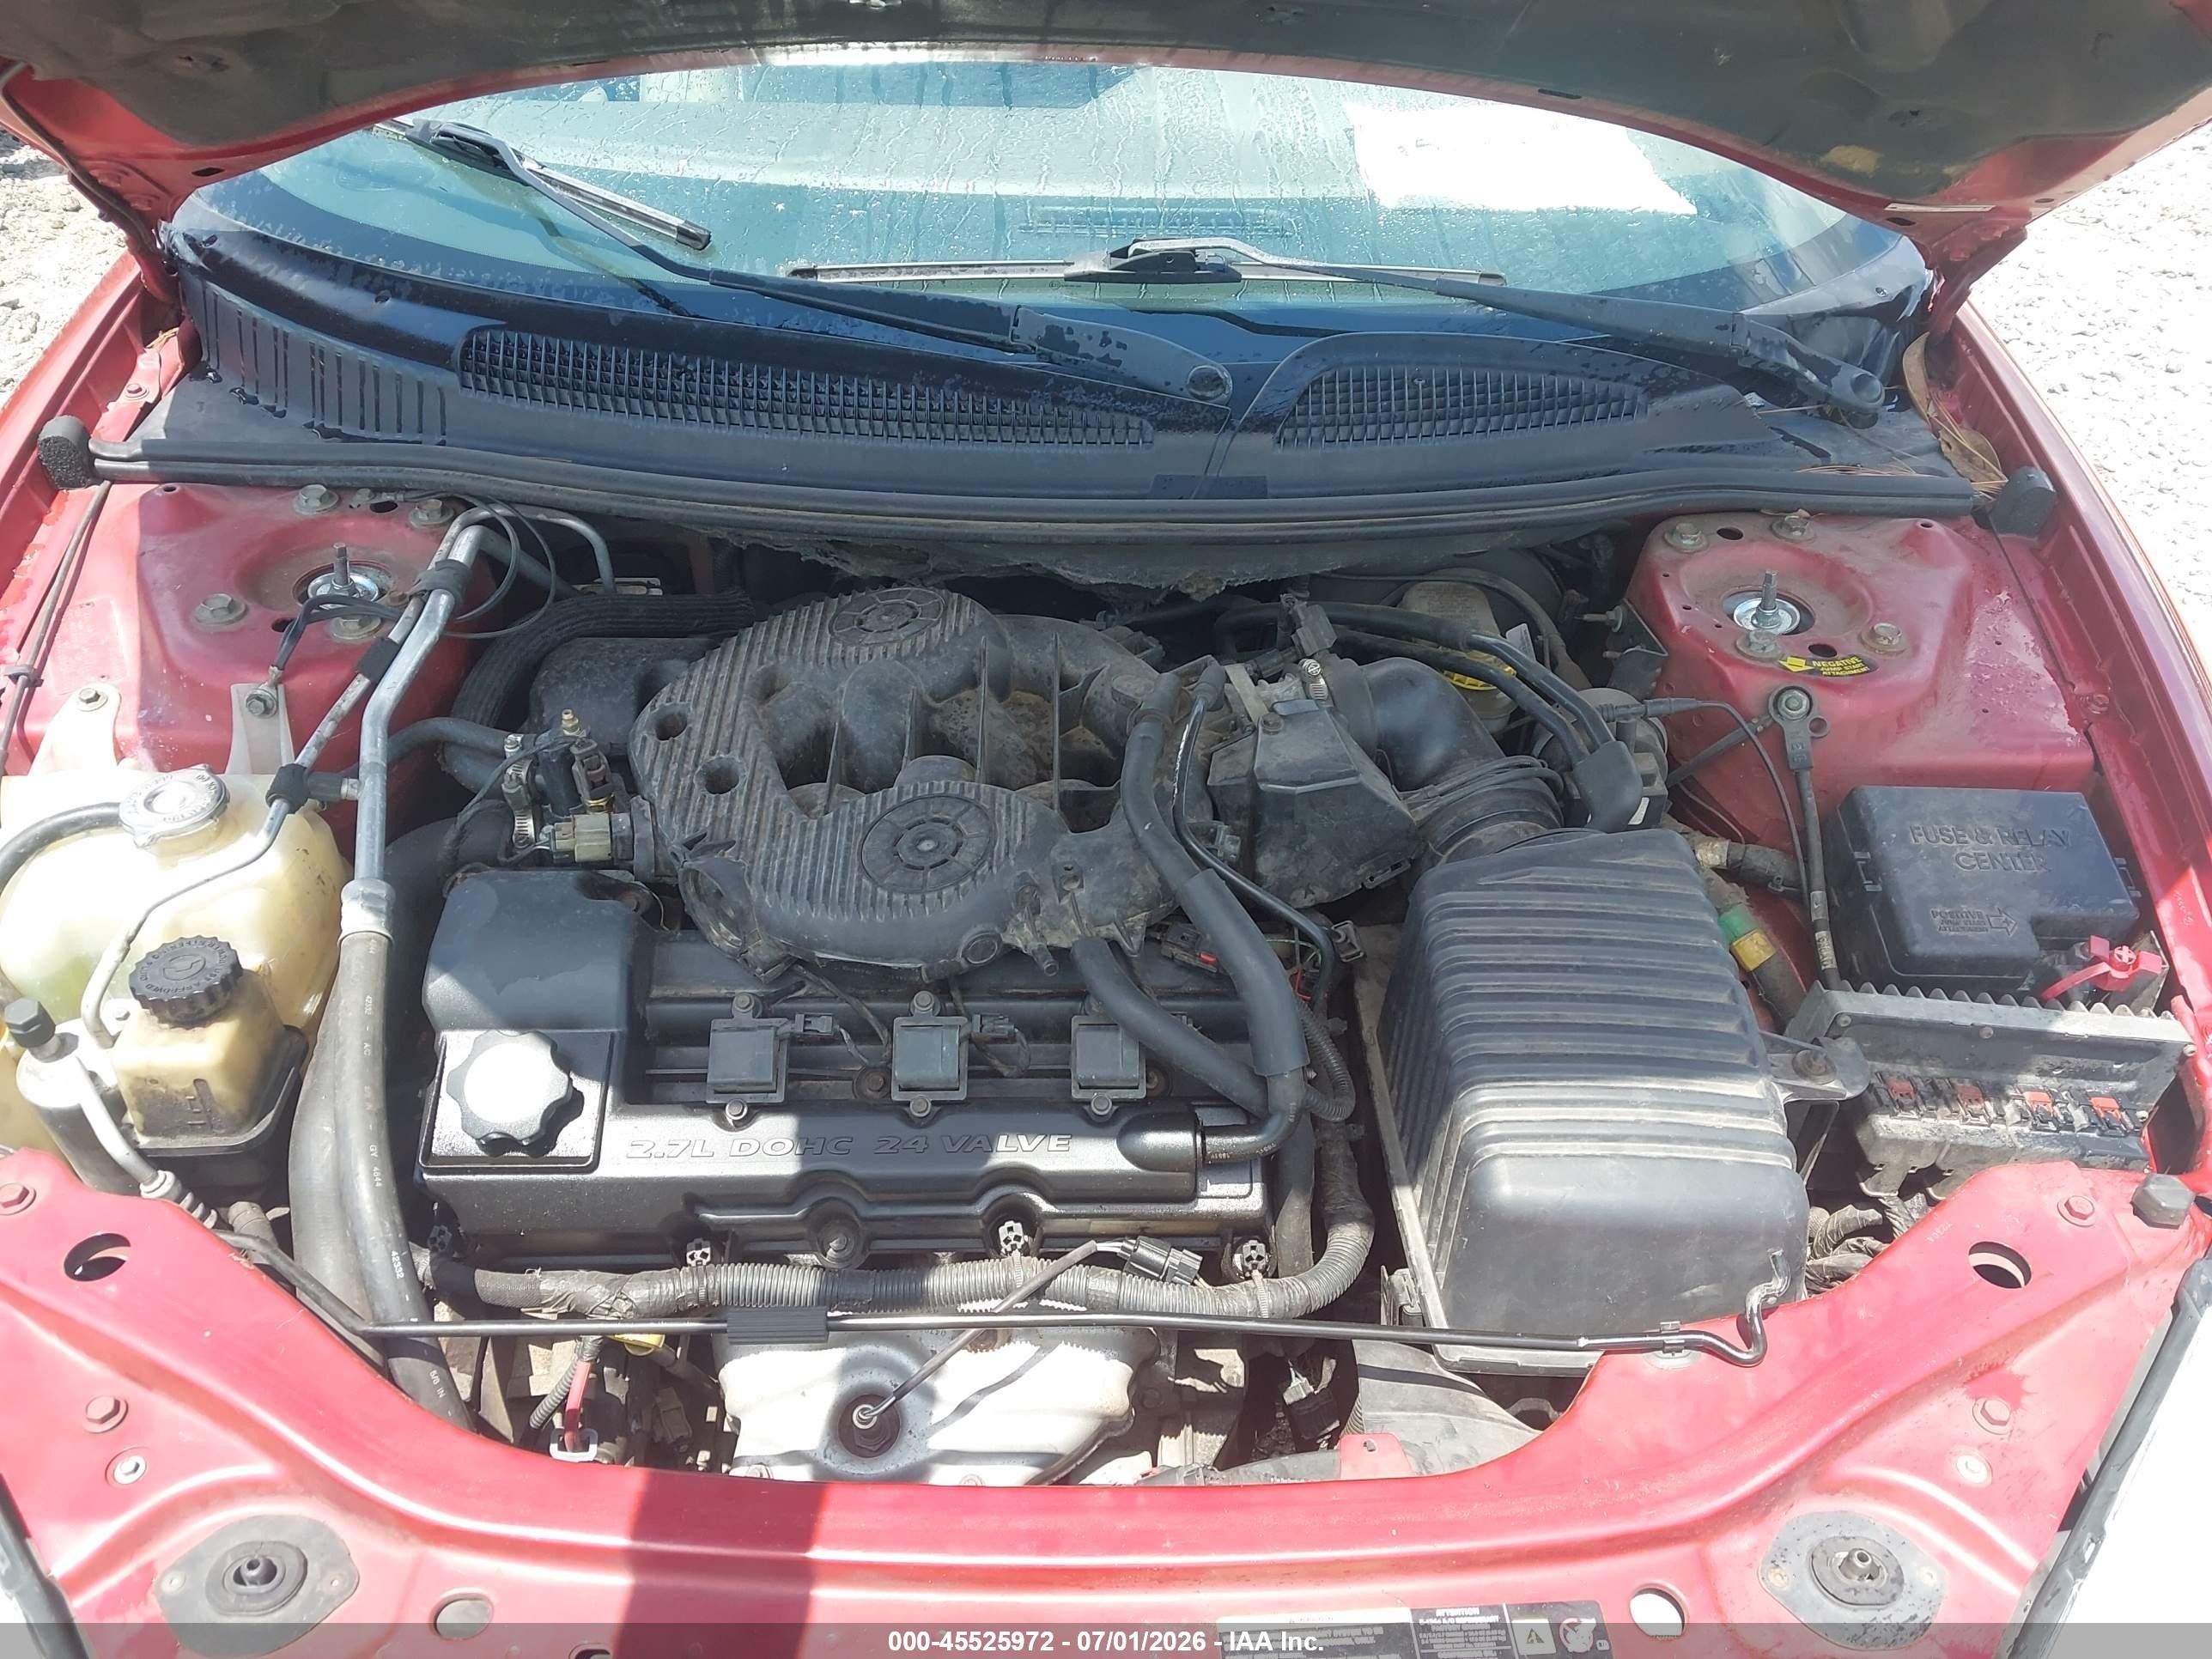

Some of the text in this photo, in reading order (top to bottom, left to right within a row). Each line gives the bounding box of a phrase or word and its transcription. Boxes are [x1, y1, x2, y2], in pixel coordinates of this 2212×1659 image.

[1812, 656, 1863, 667] NEGATIVE
[1910, 825, 2072, 847] FUSE & RELAY
[1954, 851, 2052, 872] CENTER
[626, 1133, 1073, 1159] 2.7L DOHC 24 VALVE
[369, 1144, 379, 1158] GY
[436, 1387, 447, 1398] IN
